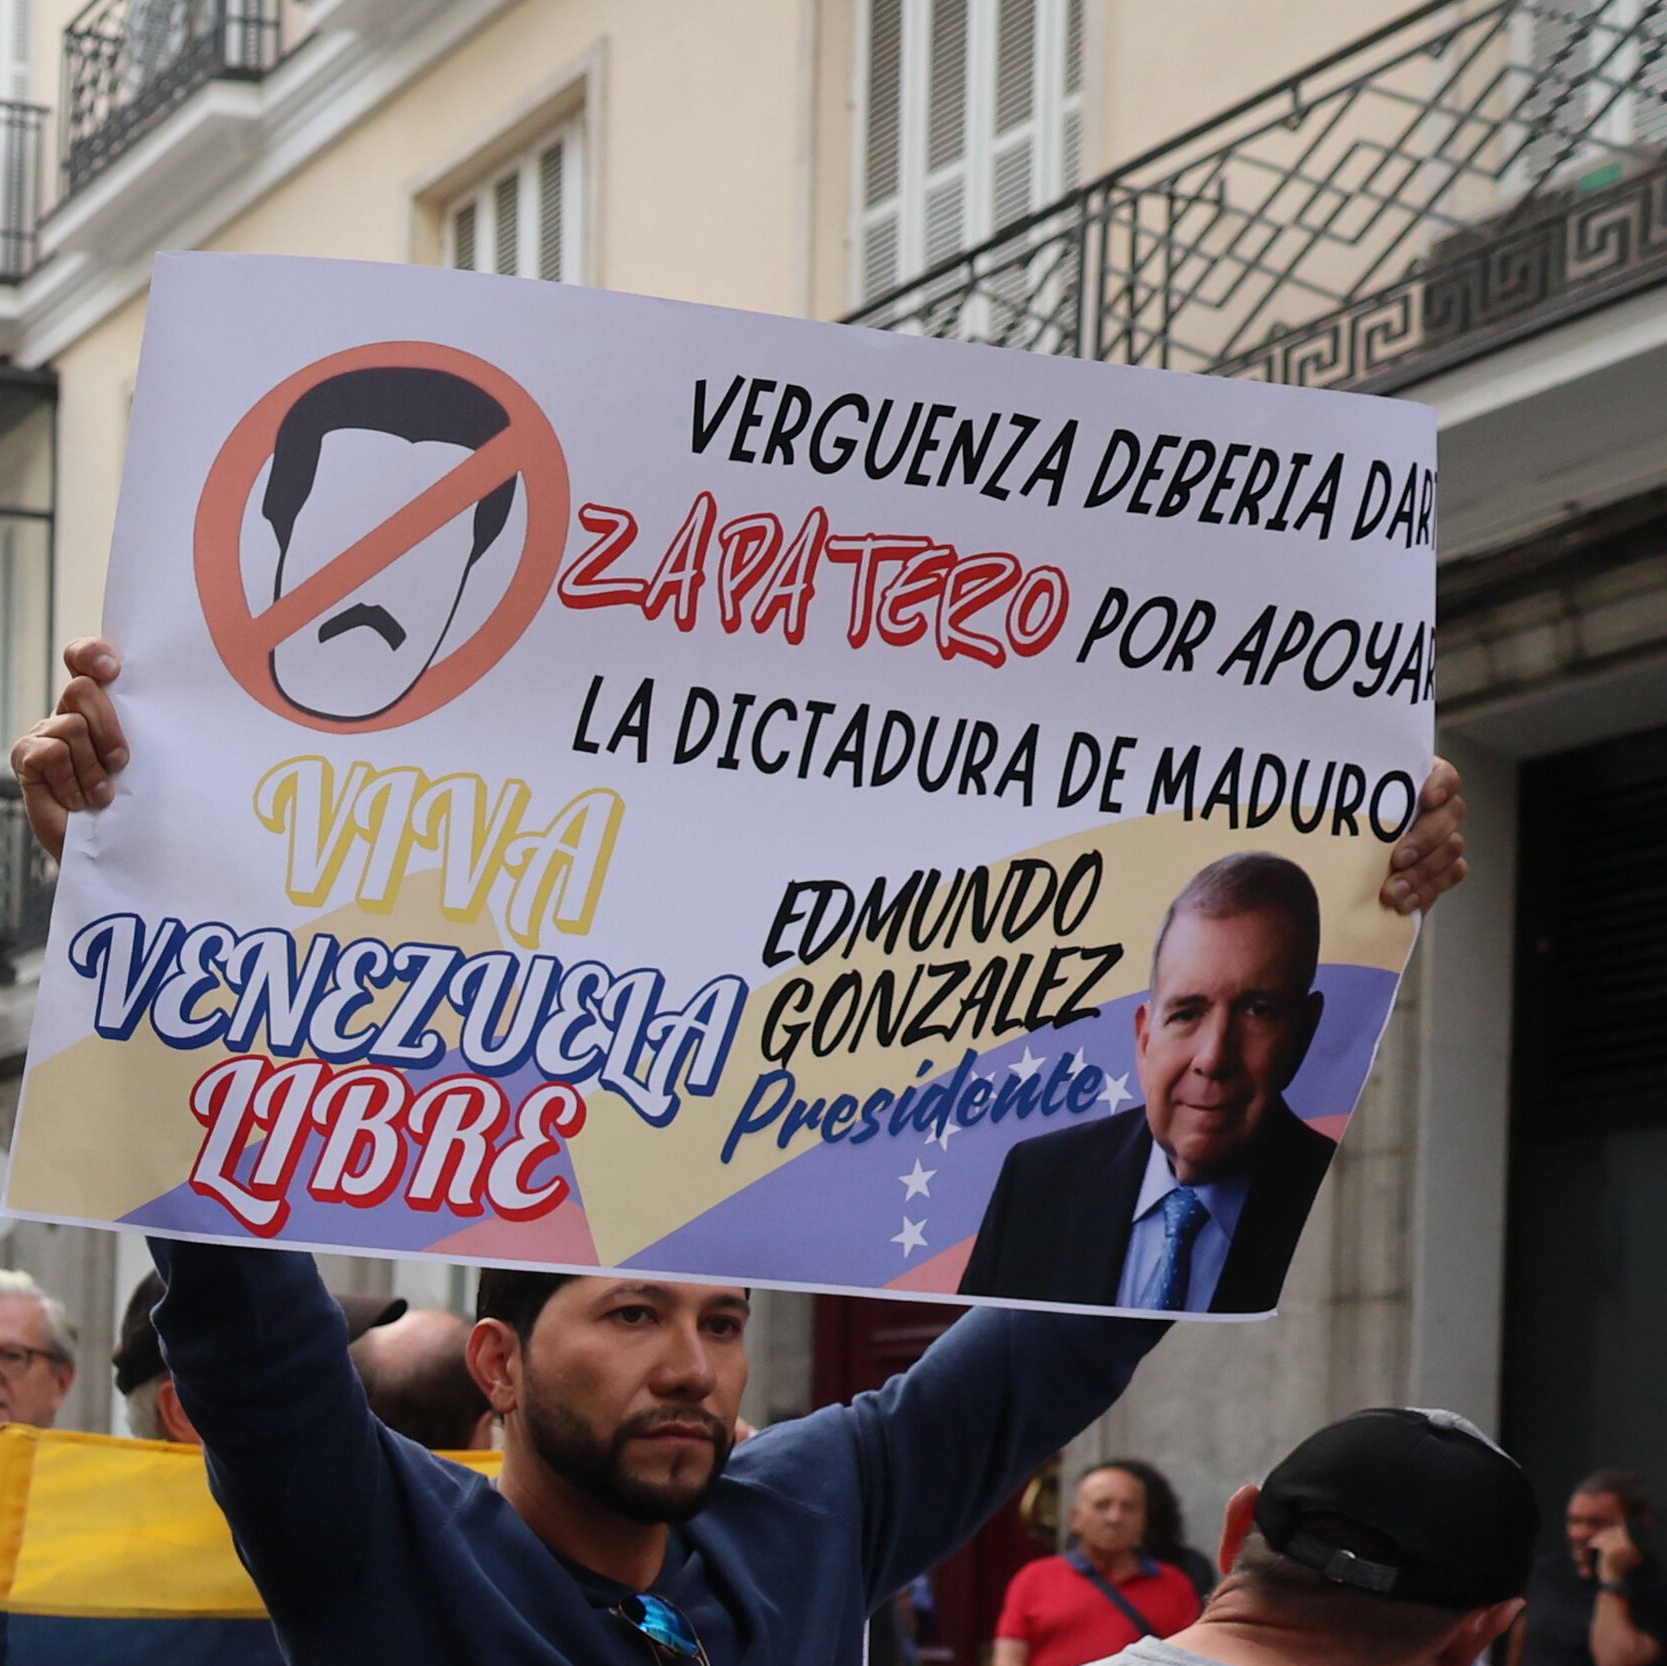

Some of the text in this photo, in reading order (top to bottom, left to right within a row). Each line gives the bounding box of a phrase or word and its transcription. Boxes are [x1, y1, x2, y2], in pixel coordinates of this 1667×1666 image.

[692, 374, 1078, 507] VERGUENZA
[1084, 429, 1346, 540] DEBERIA
[557, 491, 1070, 668] ZAPATERO
[1076, 586, 1217, 672] POR
[572, 675, 1416, 844] LA DICTADURA DE MADURO
[252, 754, 626, 950] VIVA
[761, 849, 1104, 969] EDMUNDO
[68, 911, 750, 1129] VENEZUELA
[761, 941, 1126, 1069] GONZALEZ
[189, 1054, 588, 1239] LIBRE
[719, 1048, 1104, 1164] Presidente
